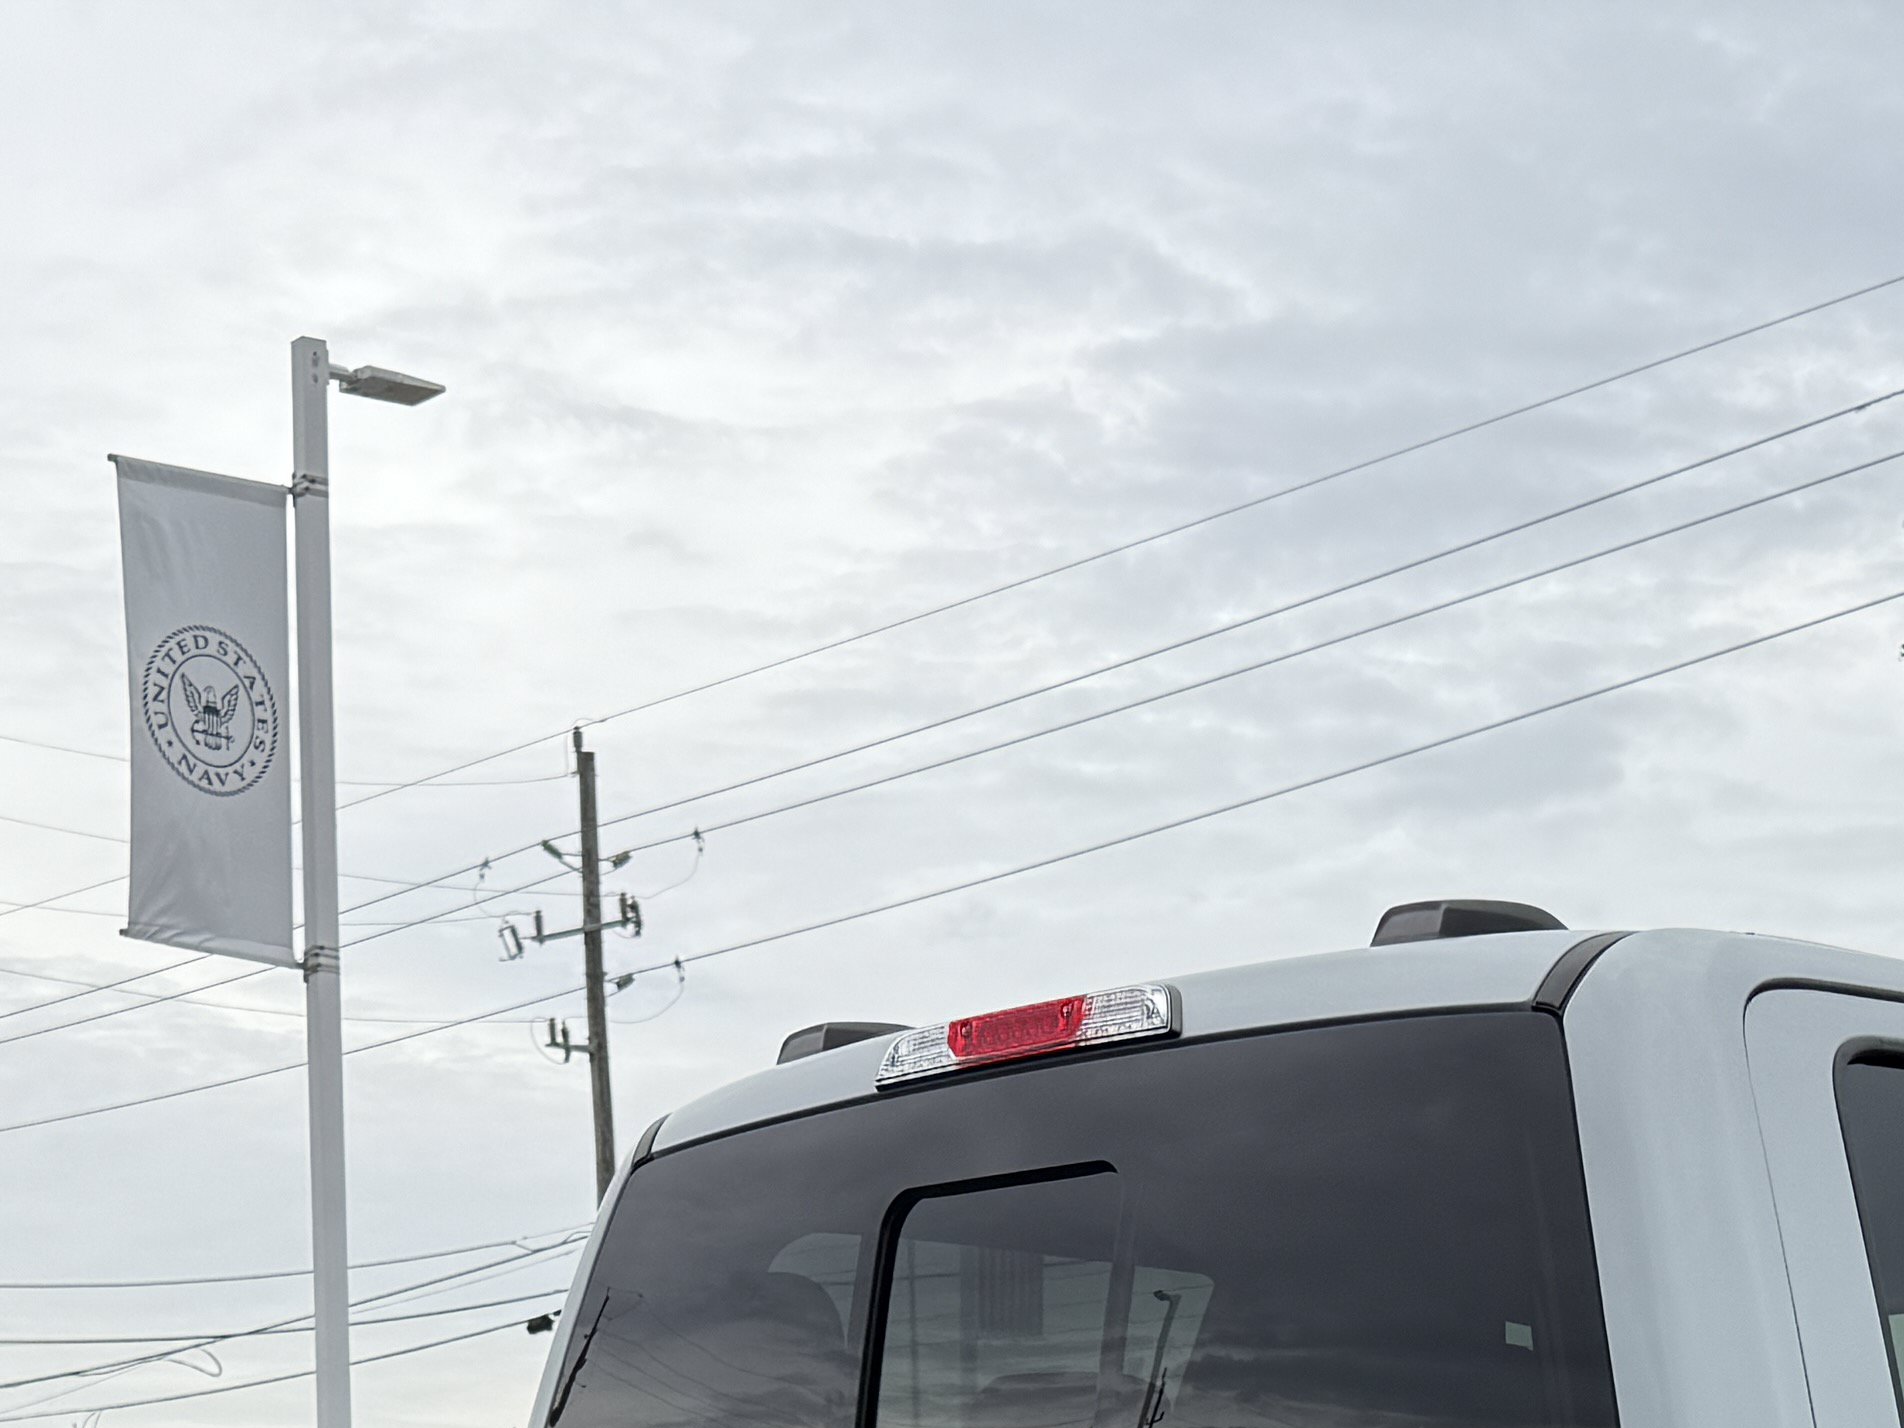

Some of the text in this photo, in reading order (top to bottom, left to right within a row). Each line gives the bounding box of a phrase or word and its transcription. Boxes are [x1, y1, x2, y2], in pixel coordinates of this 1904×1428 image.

[152, 634, 269, 753] UNITED STATES
[177, 753, 246, 787] NAVY
